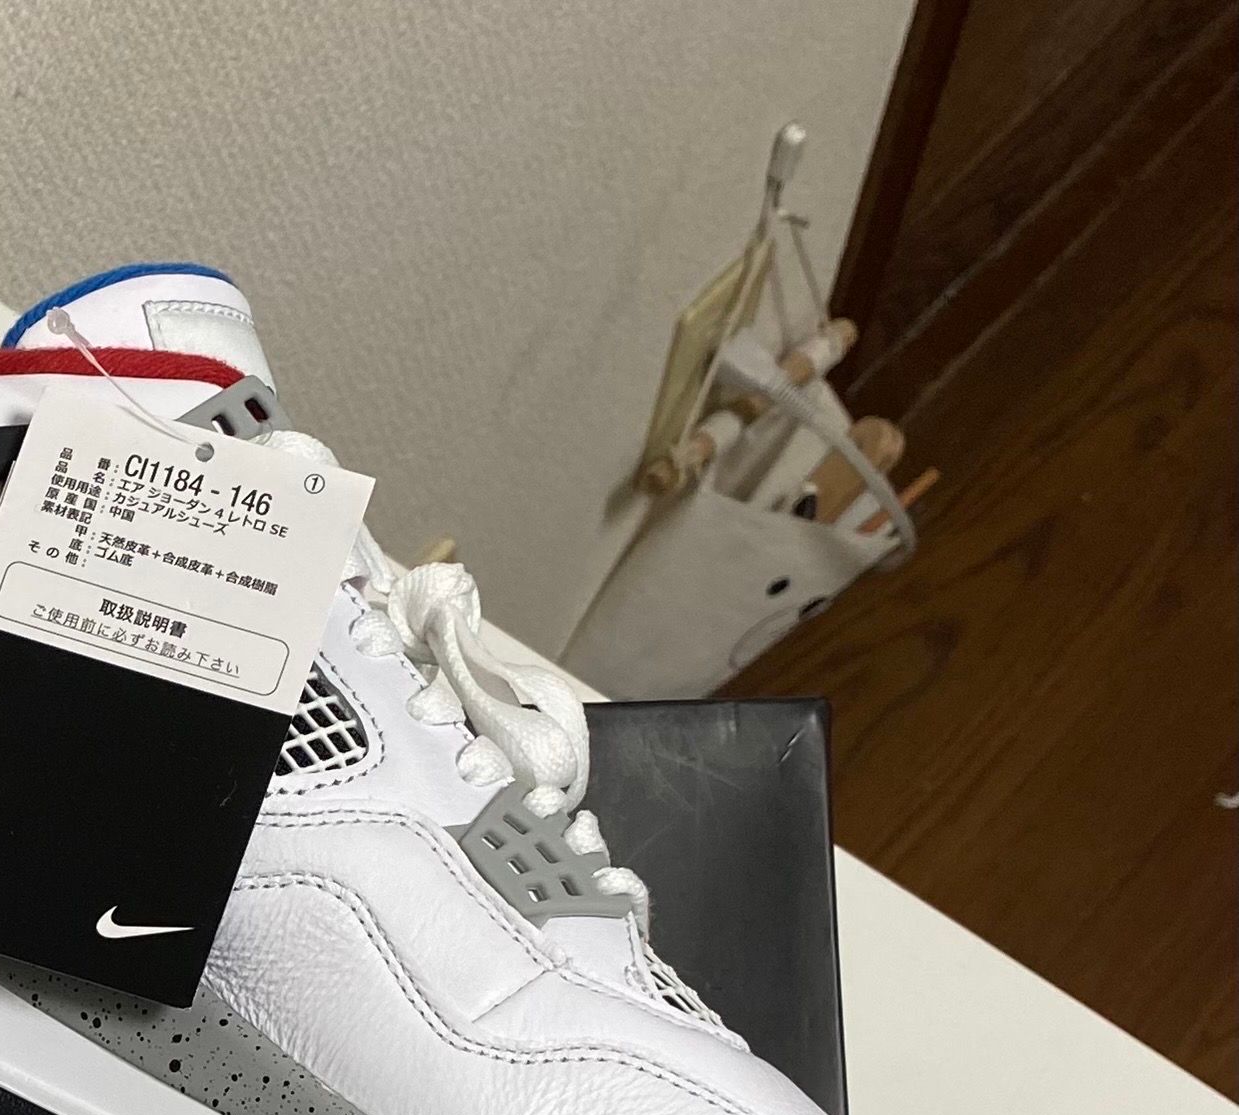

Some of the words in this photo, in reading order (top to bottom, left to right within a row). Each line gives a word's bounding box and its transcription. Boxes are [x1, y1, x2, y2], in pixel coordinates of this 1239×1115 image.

[124, 454, 205, 497] CI1184
[230, 485, 273, 516] 146
[40, 500, 93, 525] 素材表記
[109, 505, 136, 523] 中国
[227, 511, 267, 532] レトロ
[269, 523, 289, 538] SE
[98, 598, 188, 639] 取扱説明書
[31, 602, 241, 678] ご使用前に必ずお読み下さい
